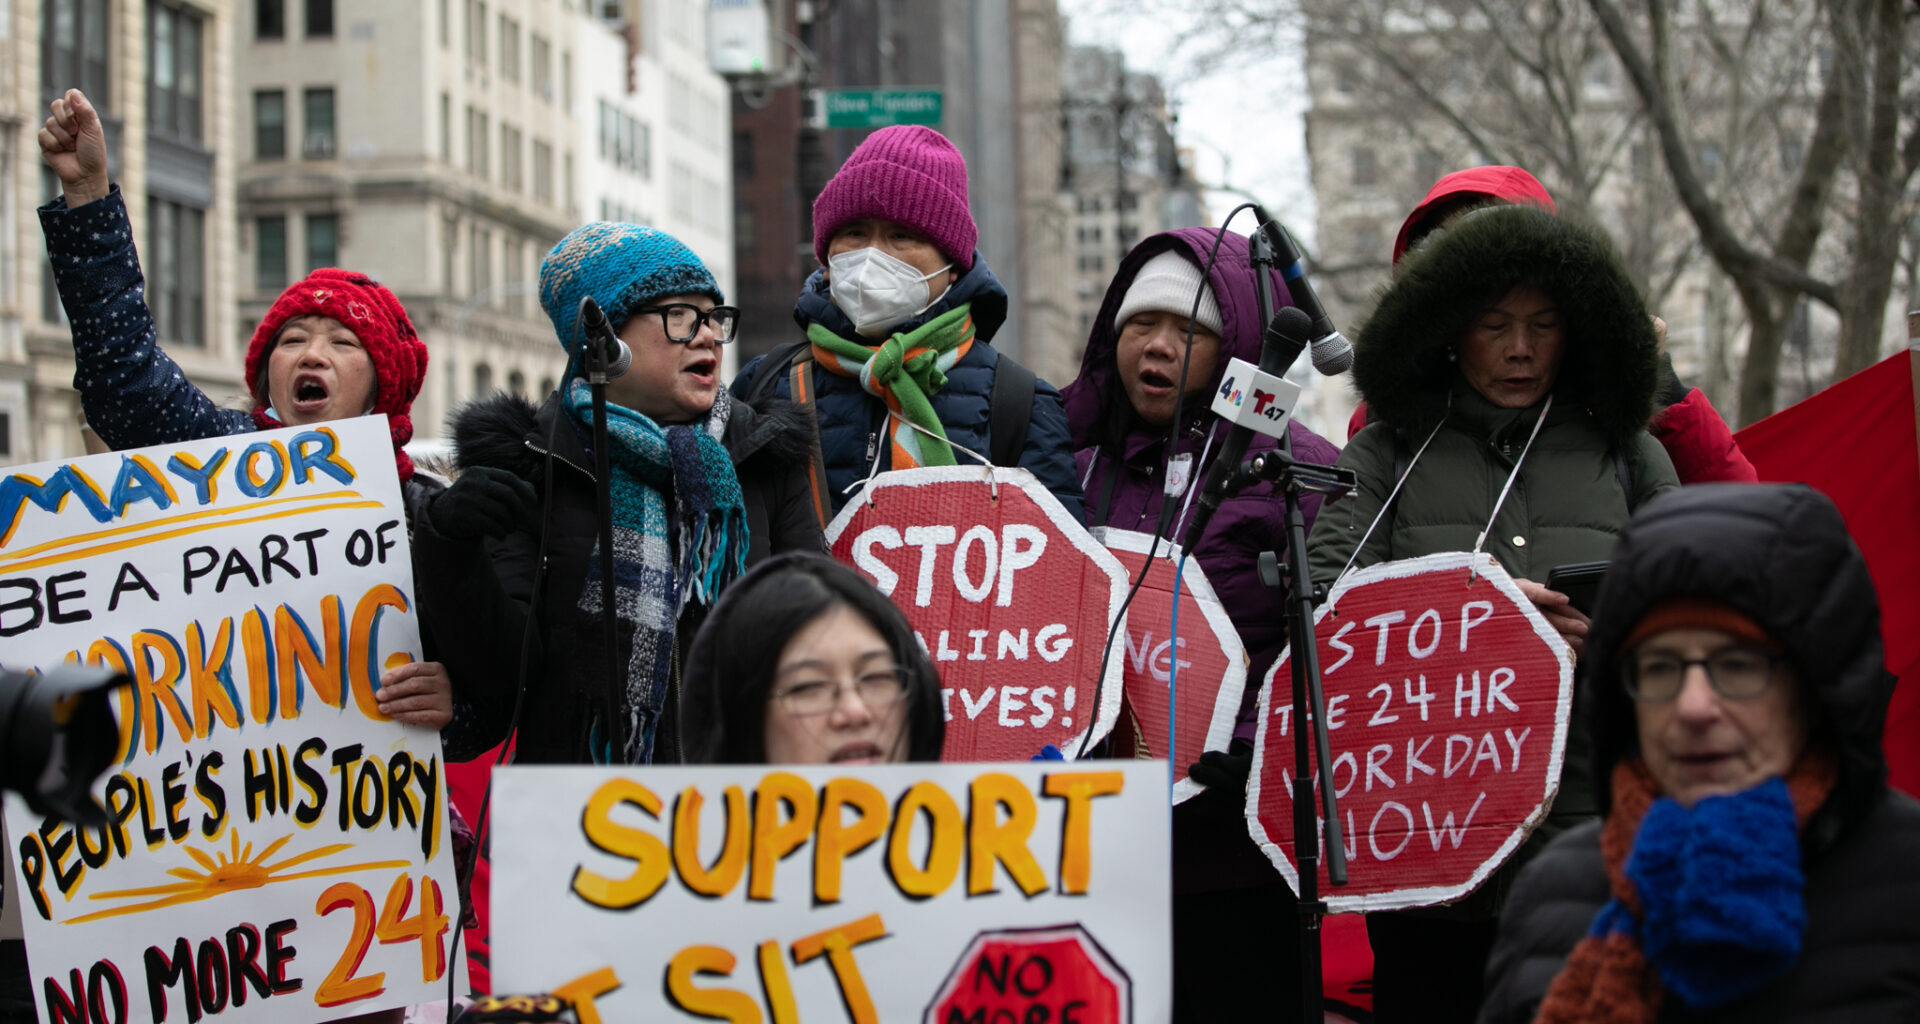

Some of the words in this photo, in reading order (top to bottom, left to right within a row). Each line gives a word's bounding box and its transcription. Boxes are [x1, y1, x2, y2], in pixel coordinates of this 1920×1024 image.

[1220, 377, 1235, 399] 4
[1264, 406, 1285, 421] 47
[0, 427, 357, 548] MAYOR
[0, 571, 92, 637] BE
[108, 562, 159, 611] A
[183, 528, 328, 594] PART
[345, 520, 399, 567] OF
[851, 524, 1048, 607] STOP
[0, 584, 412, 765] ORKING
[1324, 601, 1494, 675] STOP
[940, 685, 1076, 728] IVES!
[1275, 694, 1349, 736] TE
[1367, 674, 1436, 728] 24
[1455, 668, 1519, 718] HR
[243, 737, 440, 862] HISTORY
[570, 771, 1125, 911] SUPPORT
[44, 959, 128, 1024] NO
[144, 918, 302, 1024] MORE
[315, 872, 450, 1007] 24
[664, 913, 893, 1024] SIT
[975, 954, 1053, 997] NO
